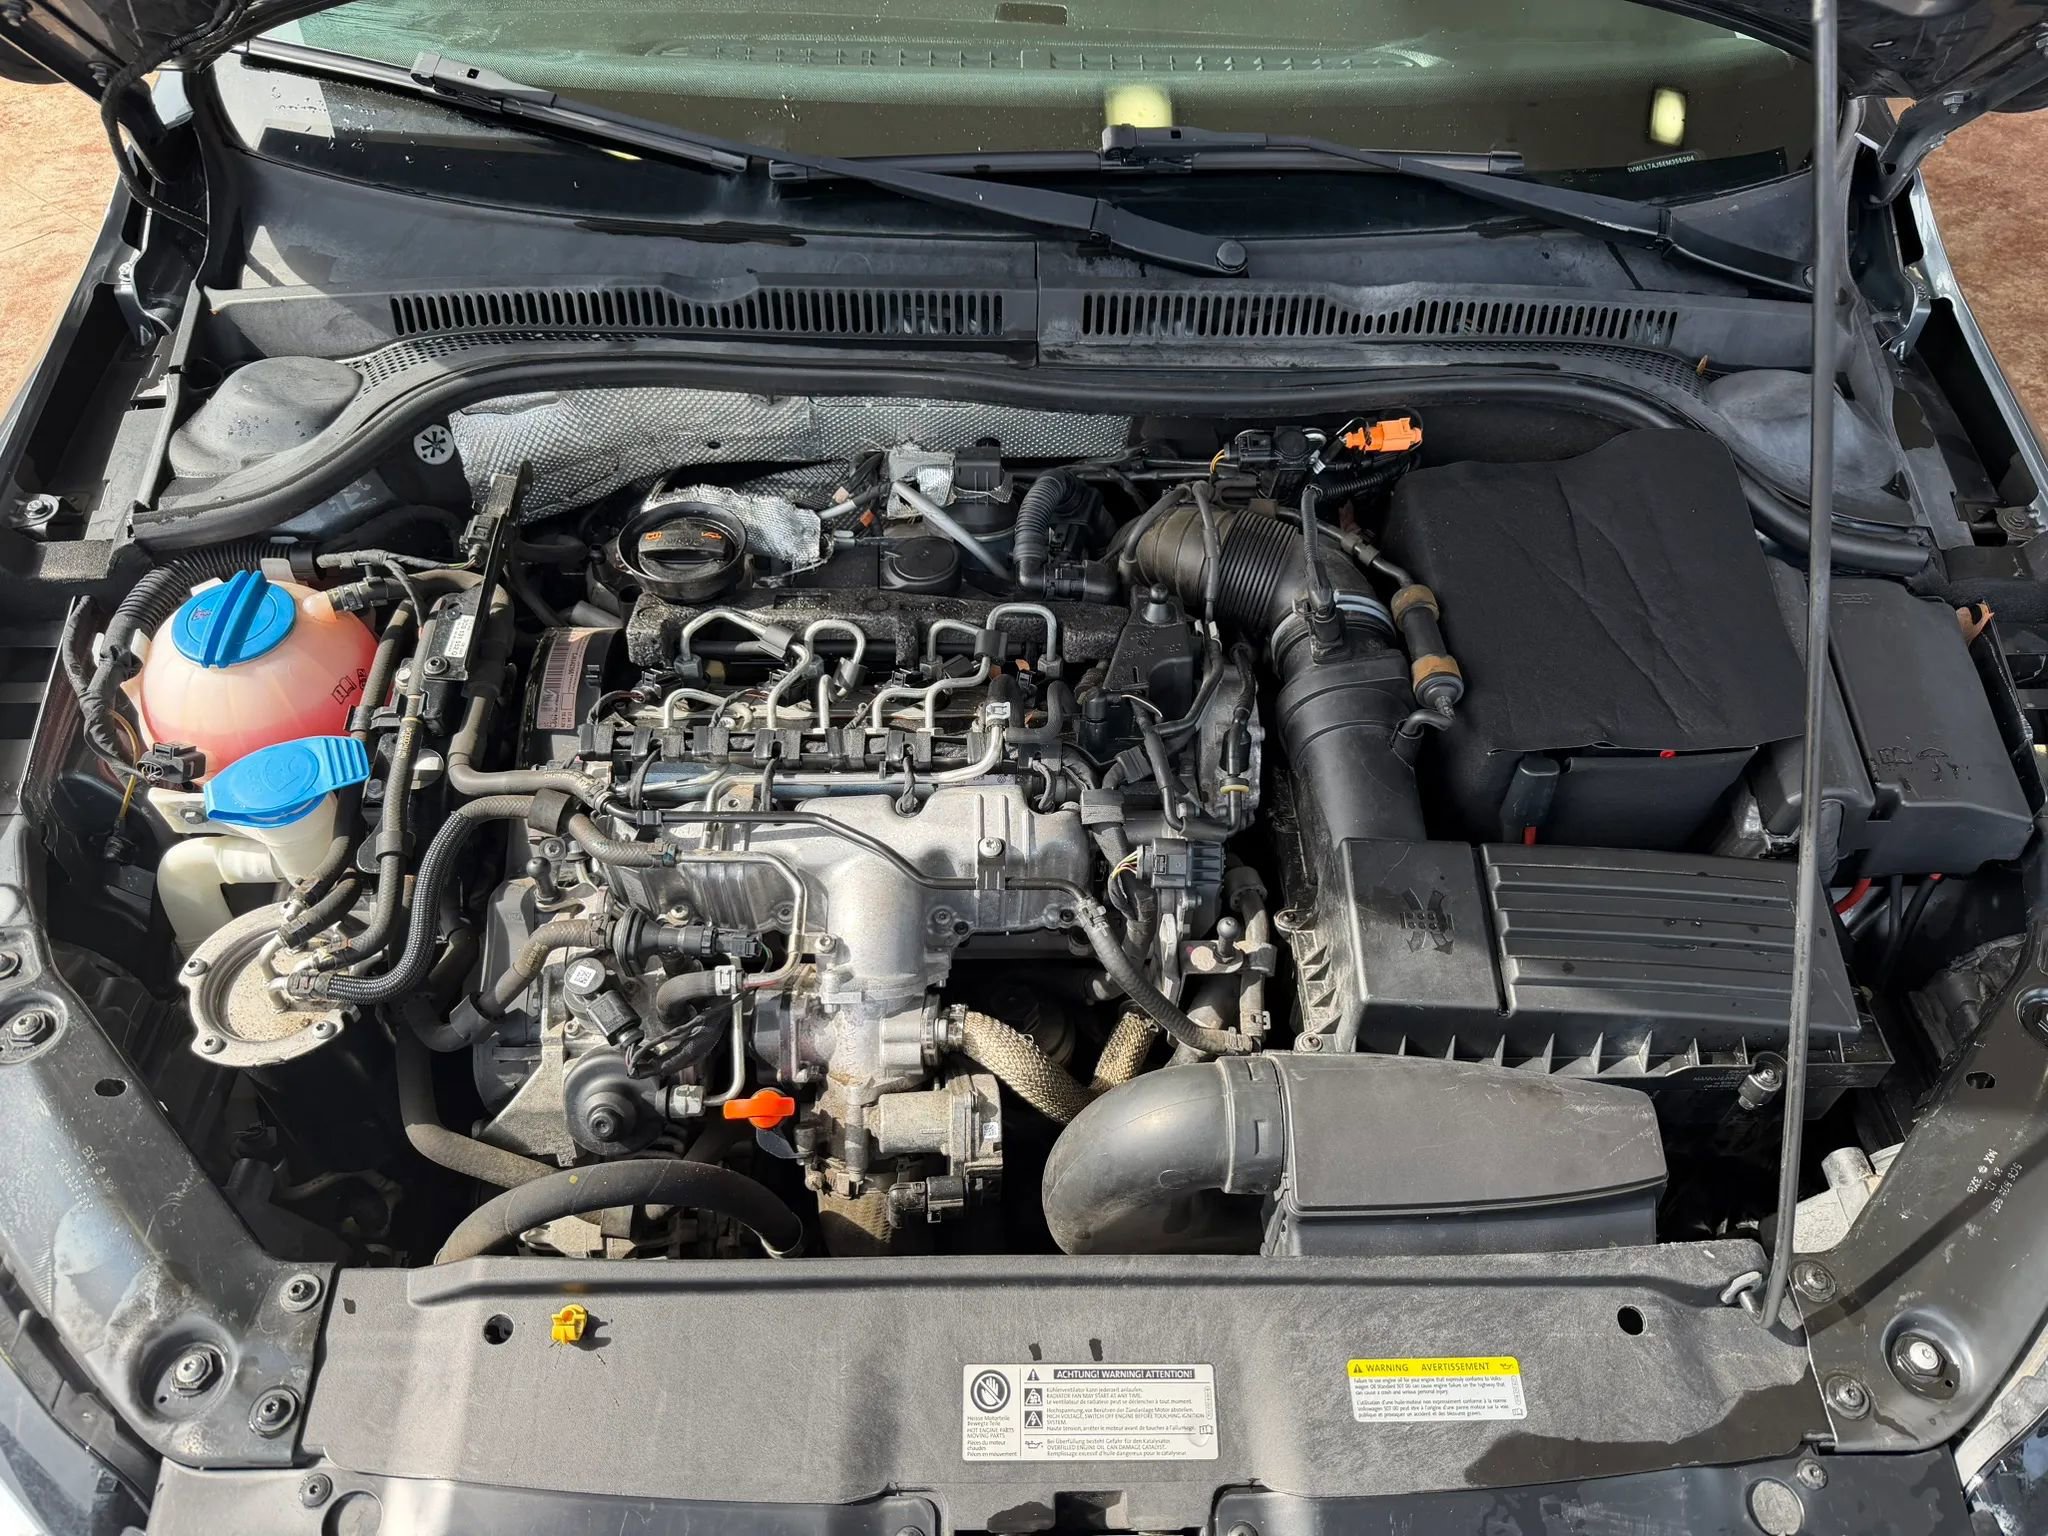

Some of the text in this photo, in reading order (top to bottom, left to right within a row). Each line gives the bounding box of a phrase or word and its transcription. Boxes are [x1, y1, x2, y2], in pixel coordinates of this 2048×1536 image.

[1366, 1362, 1489, 1372] WARNING AVERTISSEMENT
[1057, 1370, 1192, 1378] ACHTUNG! WARNING! ATTENTION!
